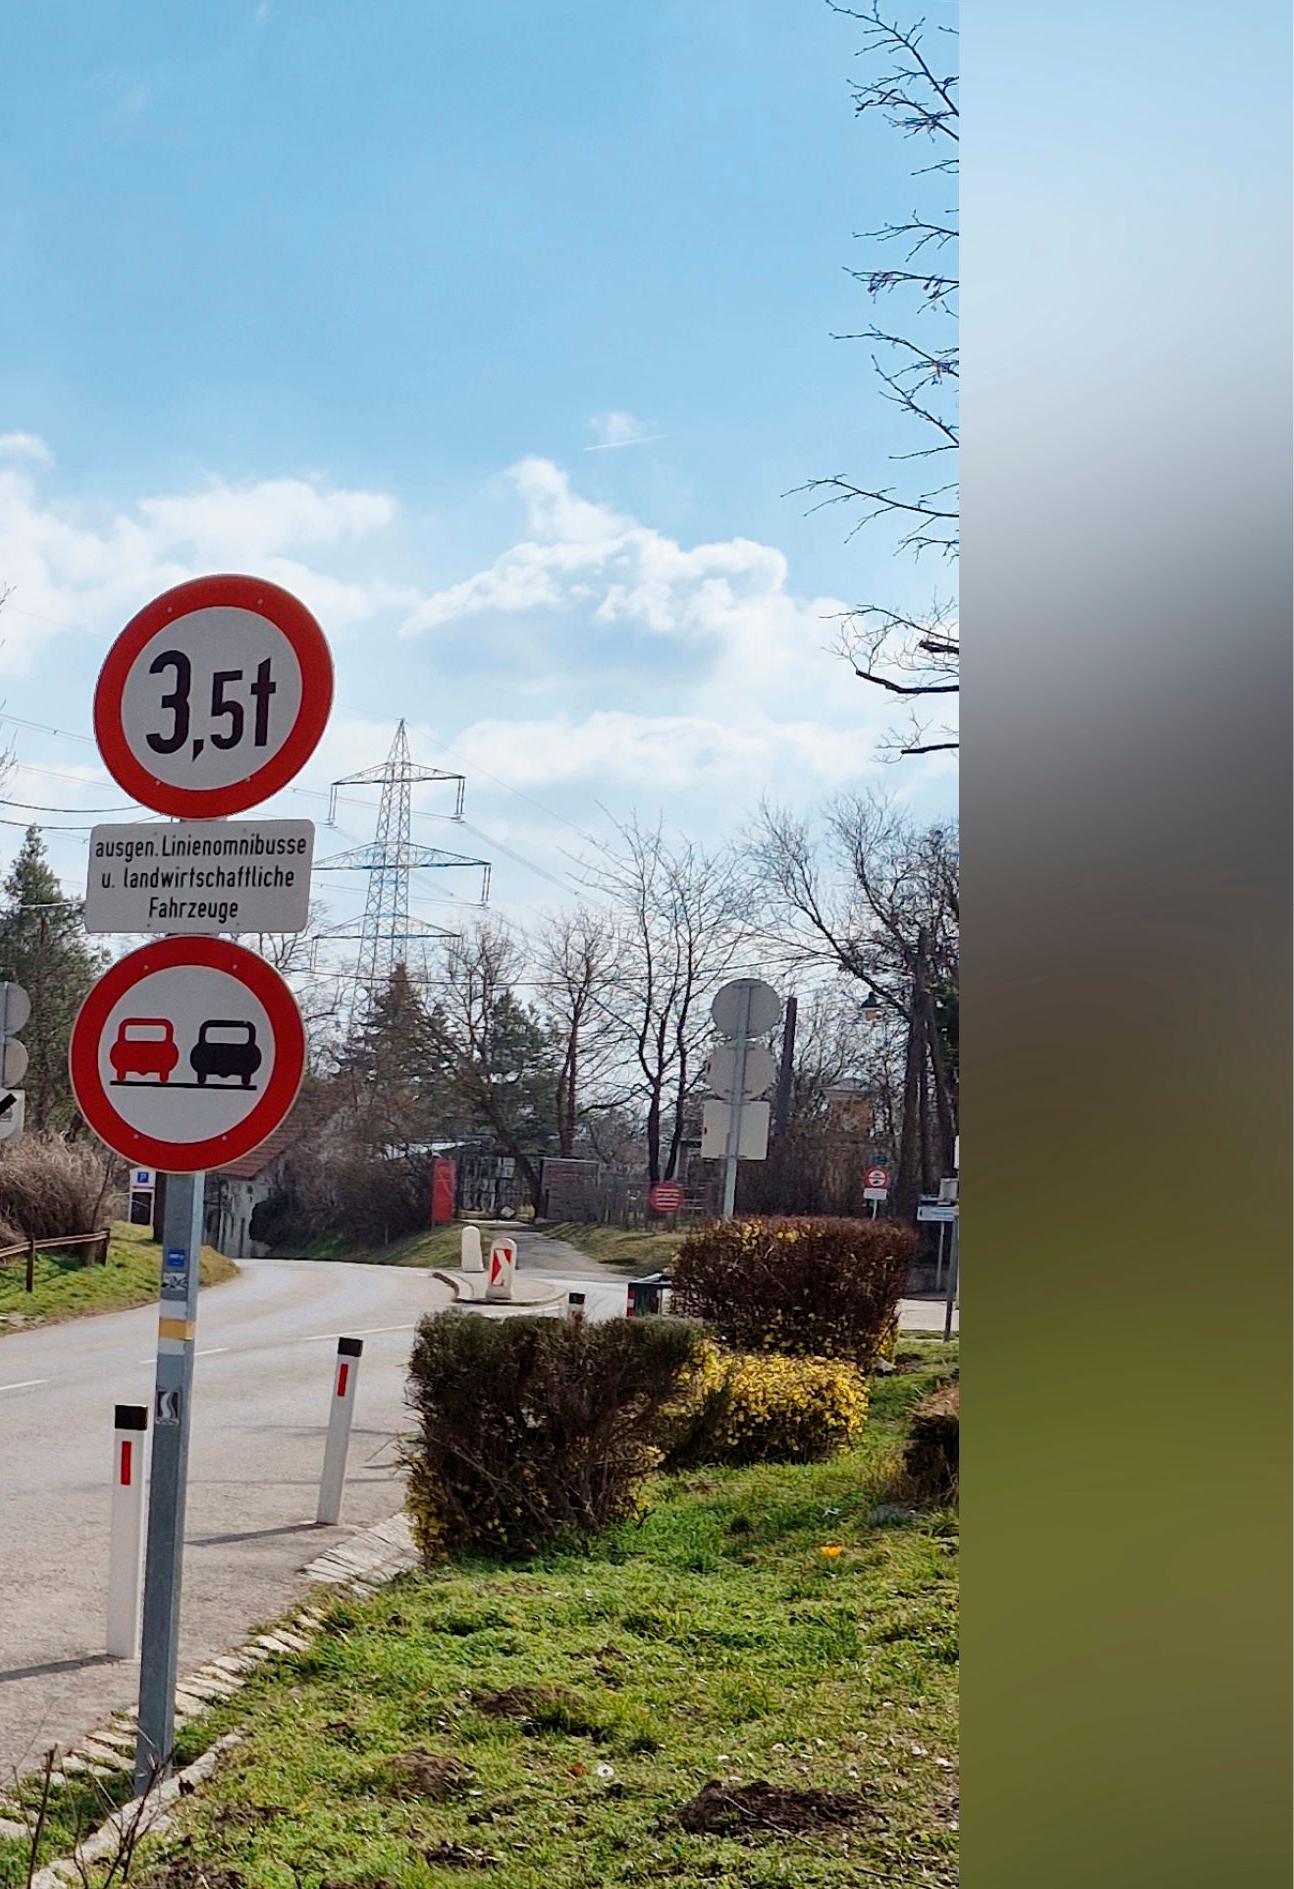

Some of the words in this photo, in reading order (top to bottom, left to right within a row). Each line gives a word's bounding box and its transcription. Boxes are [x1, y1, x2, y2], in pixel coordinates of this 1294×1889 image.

[146, 650, 277, 762] 3,5t
[96, 840, 159, 863] ausgen.
[162, 833, 307, 857] Linienomnibusse
[101, 872, 115, 888] u.
[123, 865, 295, 888] landwirtschaftliche
[149, 896, 239, 924] Fahrzeuge
